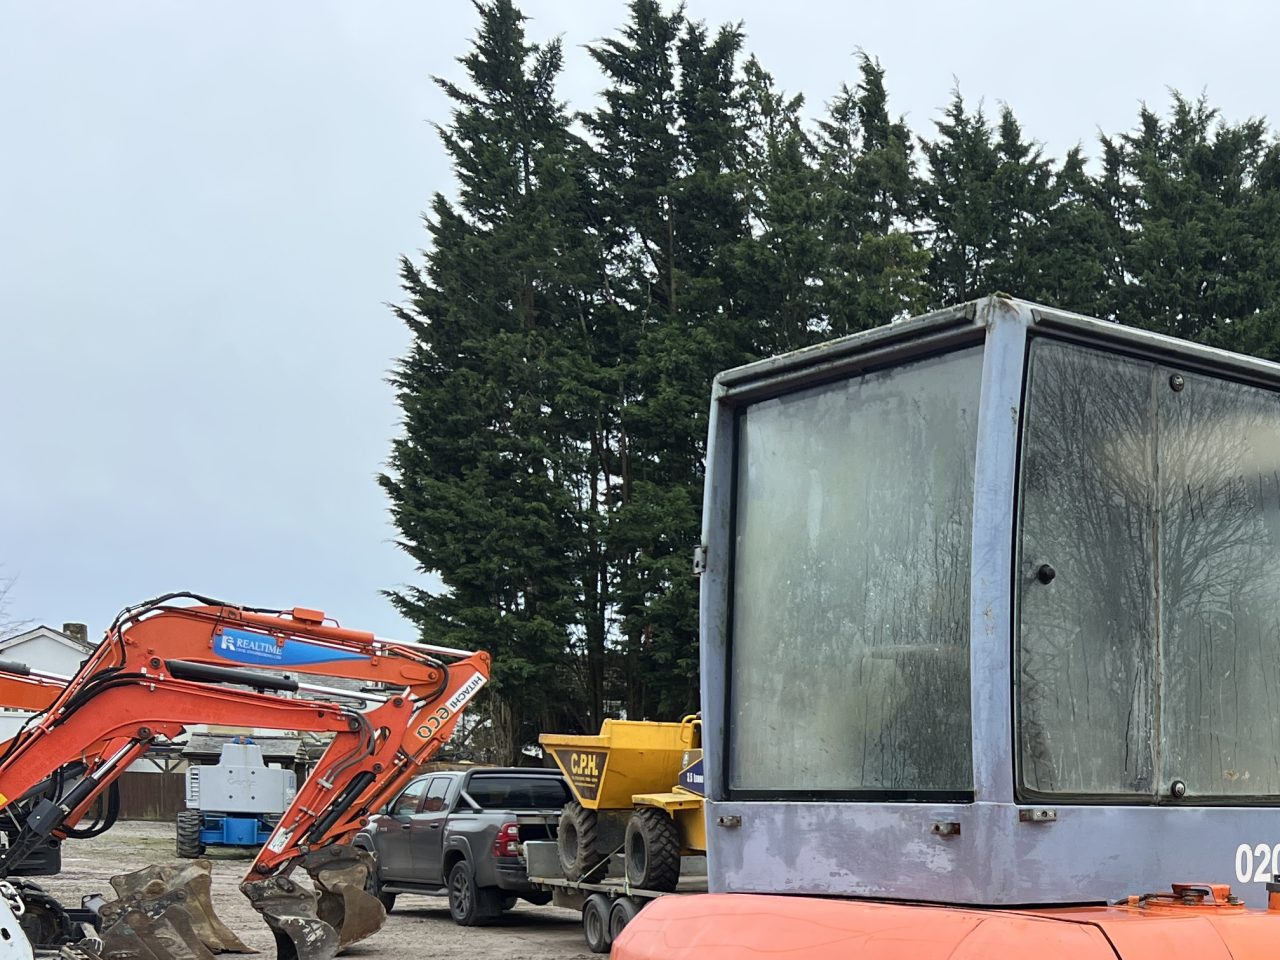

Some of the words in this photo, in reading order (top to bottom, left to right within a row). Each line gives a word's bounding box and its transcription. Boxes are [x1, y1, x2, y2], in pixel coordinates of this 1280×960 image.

[236, 638, 282, 655] REALTIME
[450, 676, 482, 709] HITACHI
[571, 753, 598, 776] C.P.H.
